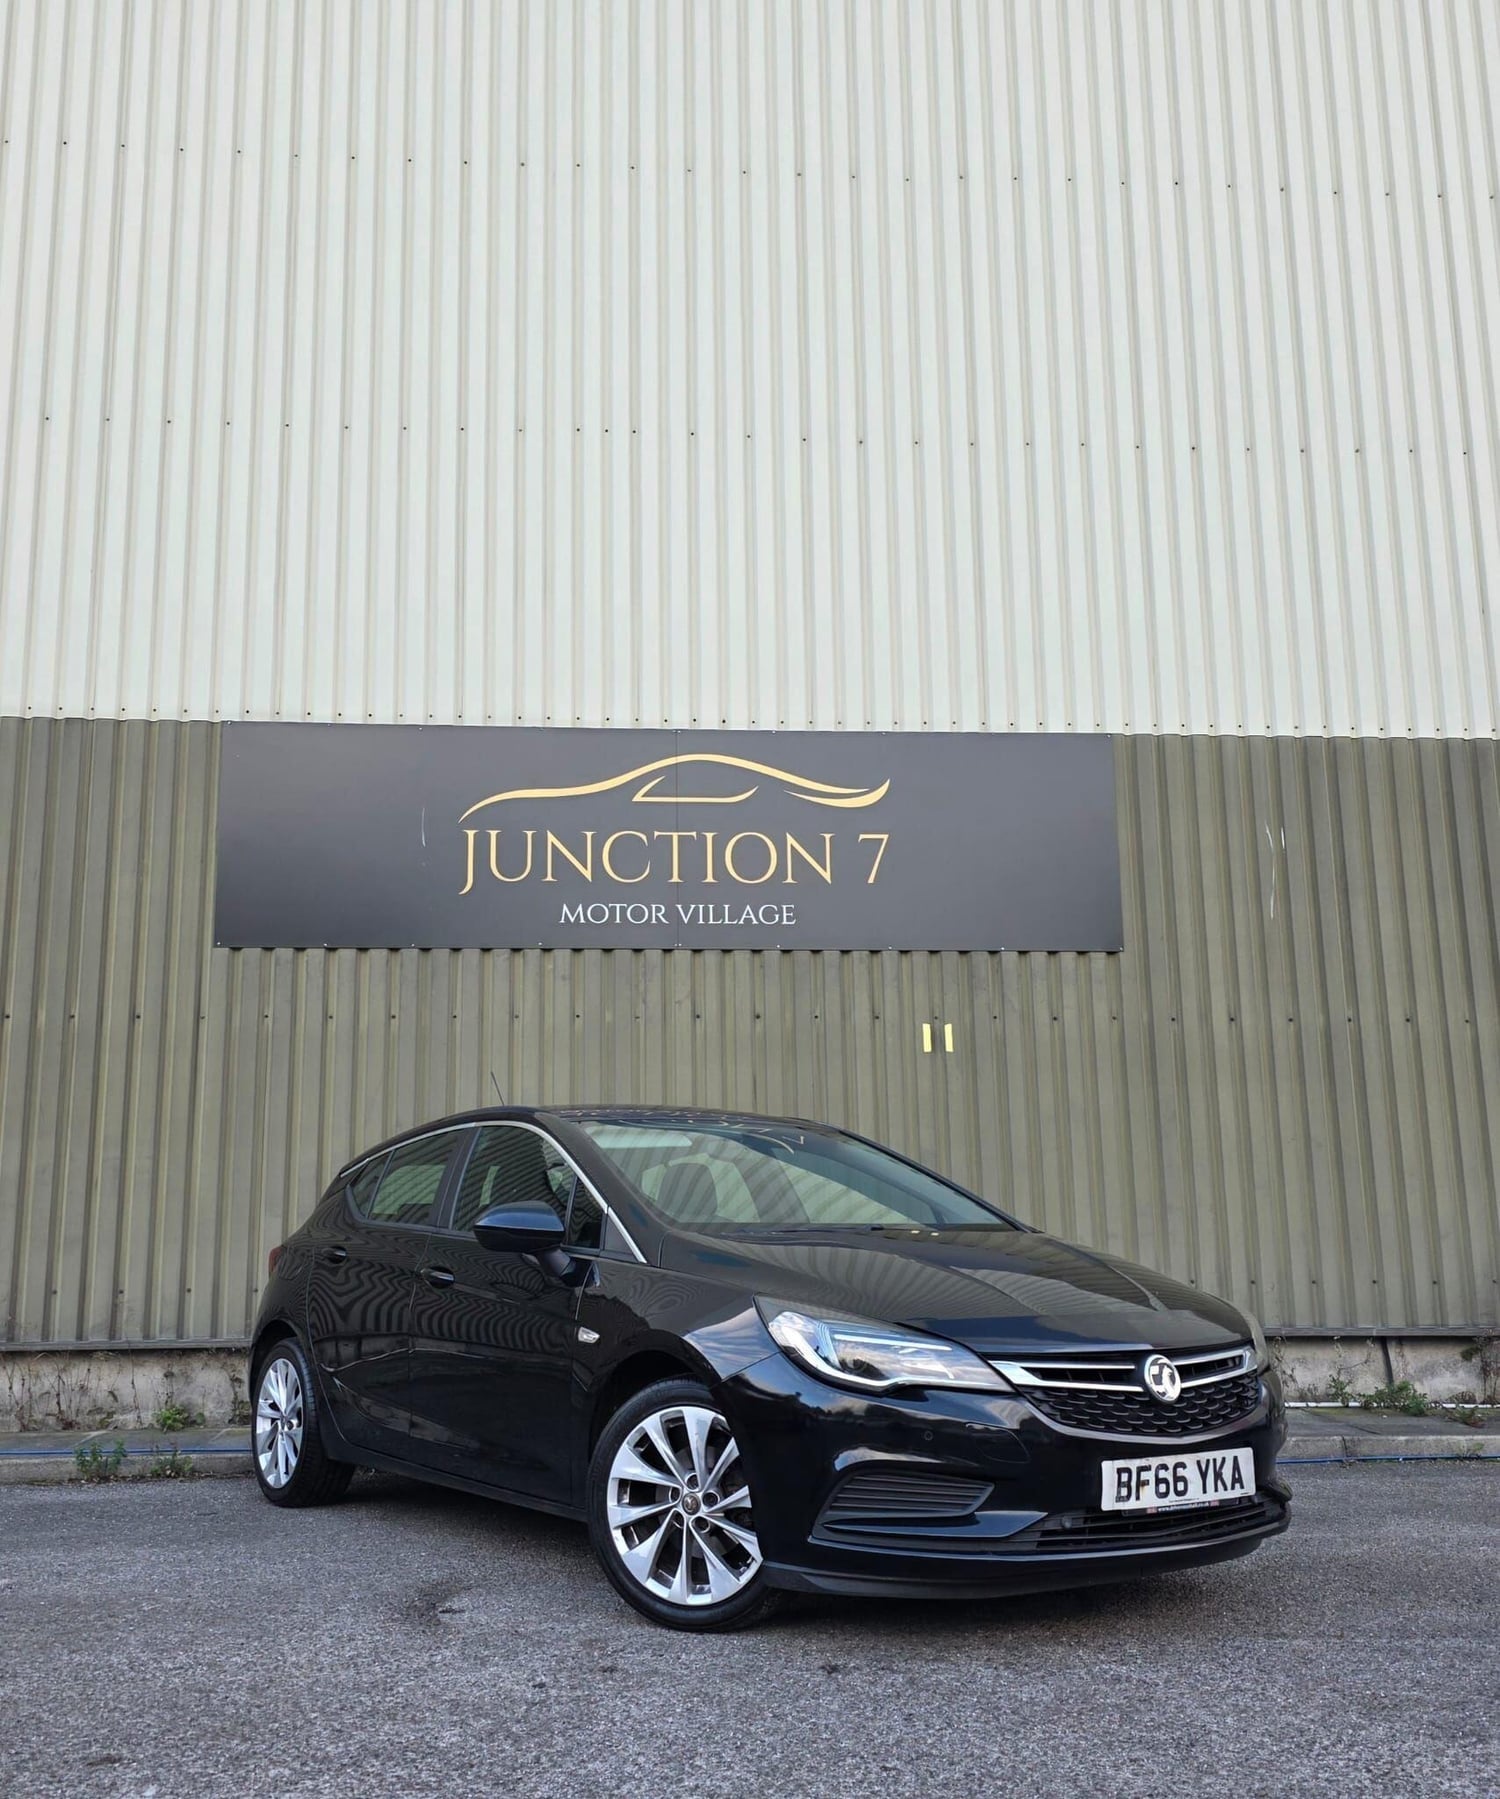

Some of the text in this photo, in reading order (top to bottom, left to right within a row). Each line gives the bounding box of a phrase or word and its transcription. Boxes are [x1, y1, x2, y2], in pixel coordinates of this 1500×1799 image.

[459, 829, 889, 894] JUNCTION 7
[559, 903, 797, 925] MOTOR VILLAGE
[1115, 1455, 1245, 1503] BF66 YKA
